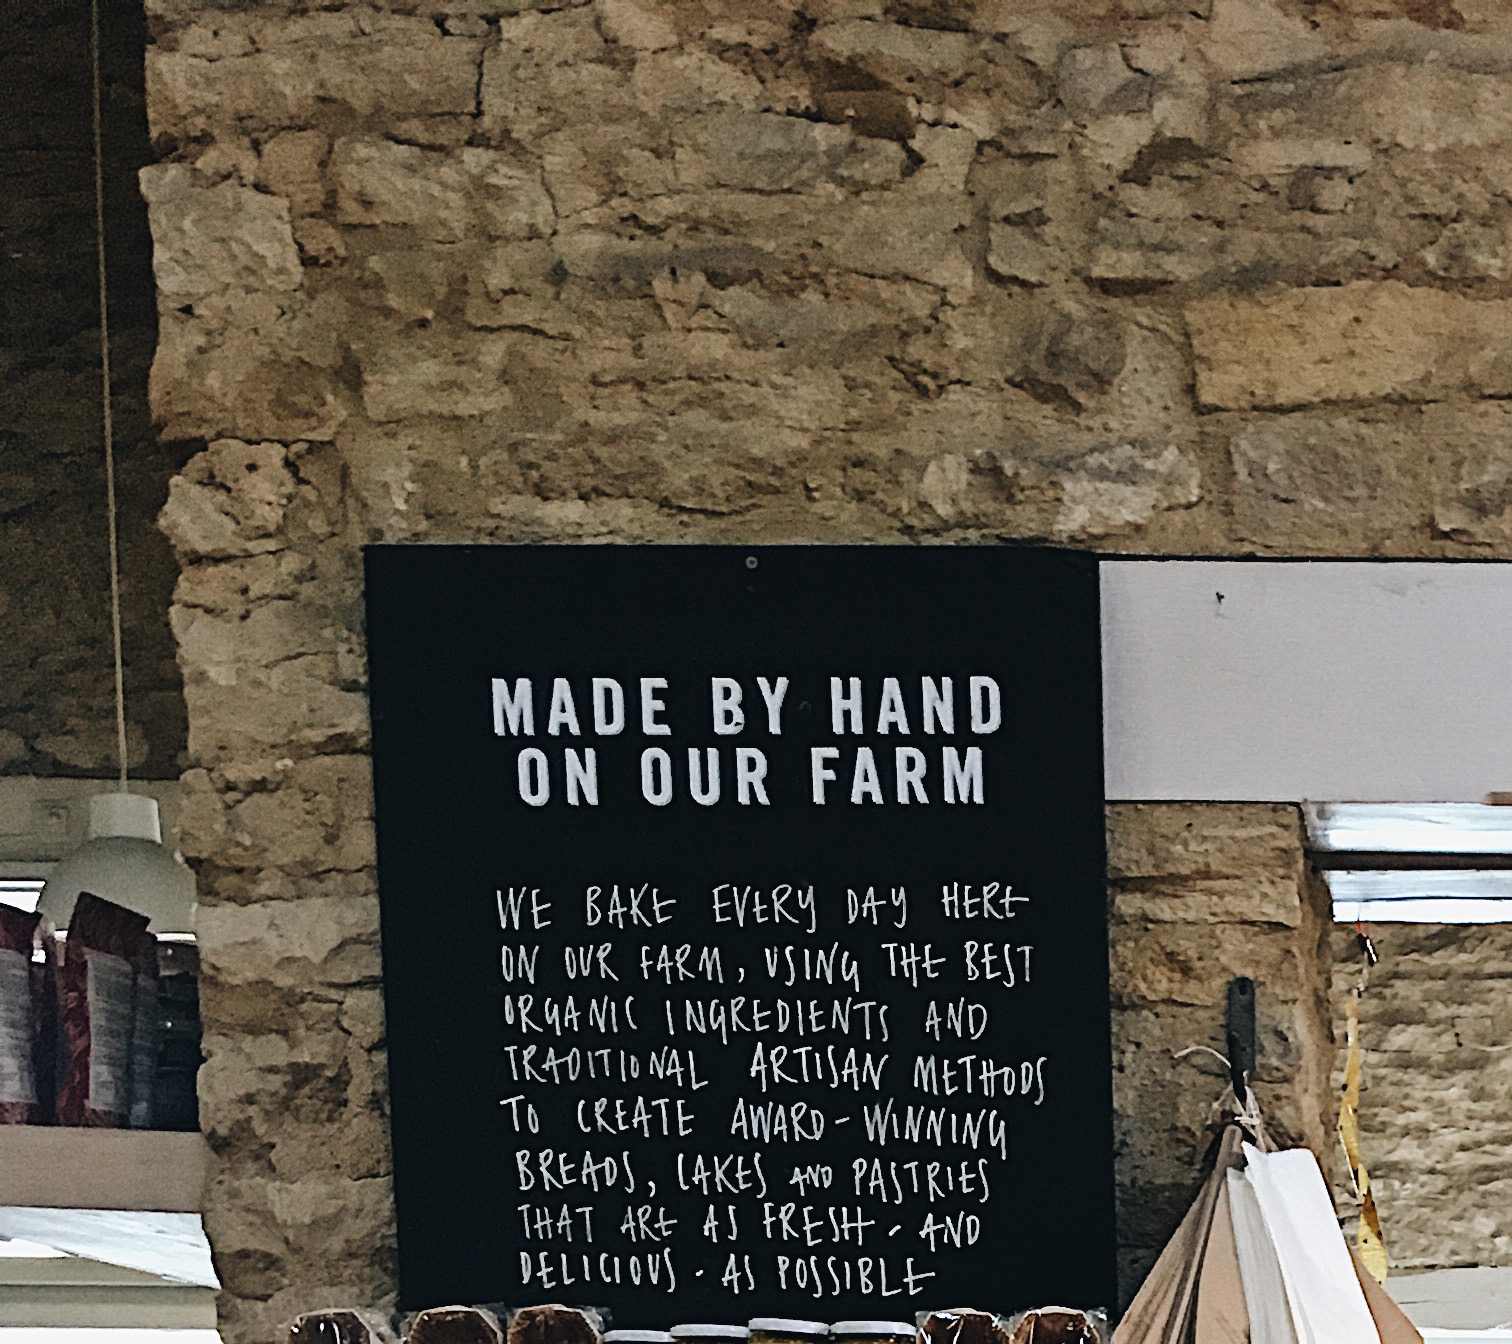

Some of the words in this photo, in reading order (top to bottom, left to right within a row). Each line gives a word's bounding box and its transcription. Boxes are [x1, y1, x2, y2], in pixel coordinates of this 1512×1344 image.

[492, 678, 671, 736] MADE
[712, 677, 789, 735] BY
[831, 676, 1001, 734] HAND
[518, 748, 598, 806] ON
[641, 747, 770, 806] OUR
[811, 746, 984, 804] FARM
[497, 887, 551, 930] WE
[587, 883, 676, 929] BAKE
[712, 884, 816, 933] EVERY
[848, 886, 906, 928] DAY
[941, 882, 1029, 919] HERE
[502, 945, 539, 984] ON
[565, 943, 619, 981] OUR
[640, 944, 744, 984] FARM,
[765, 942, 859, 992] USING
[881, 943, 946, 986] THE
[964, 941, 1033, 987] BEST
[505, 994, 637, 1036] ORGANIC
[666, 997, 888, 1045] INGREDIENTS
[926, 997, 987, 1041] AND
[504, 1045, 708, 1090] TRADITIONAL
[750, 1042, 888, 1092] ARTISAN
[914, 1055, 1047, 1105] METHODS
[500, 1095, 539, 1133] TO
[578, 1096, 694, 1137] CREATE
[516, 1149, 655, 1197] BREADS,
[678, 1152, 766, 1198] CAKES
[789, 1164, 832, 1194] AND
[853, 1158, 989, 1204] PASTRIES
[518, 1204, 593, 1242] THAT
[620, 1205, 677, 1242] ARE
[703, 1204, 737, 1243] AS
[919, 1211, 979, 1252] AND
[520, 1247, 675, 1292] DELICIOUS
[722, 1253, 754, 1294] AS
[778, 1256, 935, 1298] POSSIBLE
